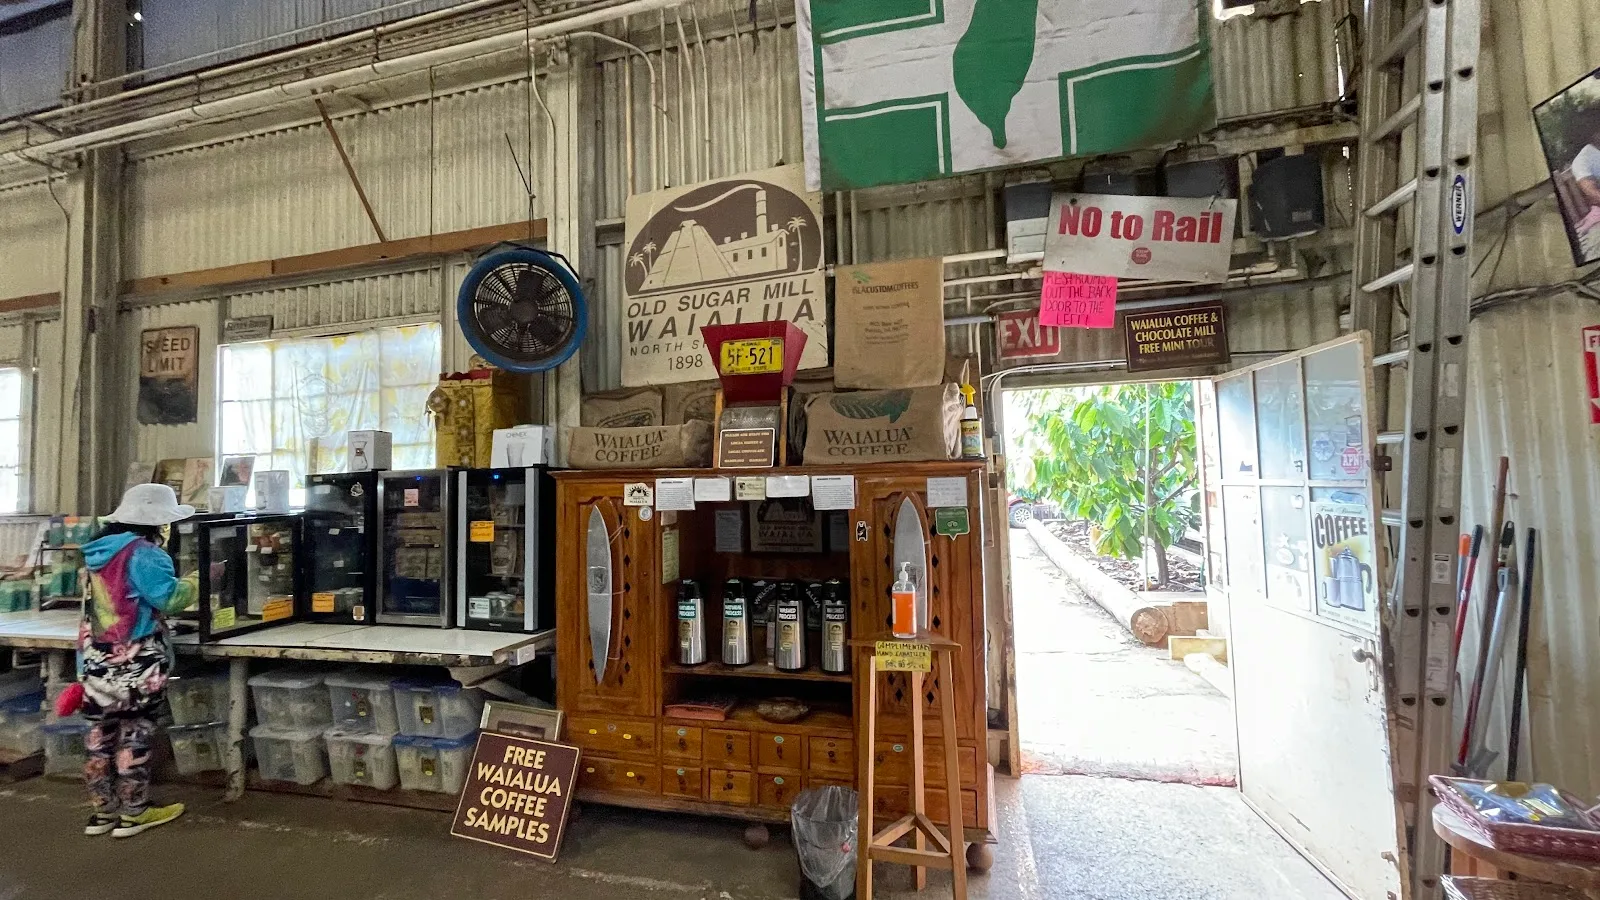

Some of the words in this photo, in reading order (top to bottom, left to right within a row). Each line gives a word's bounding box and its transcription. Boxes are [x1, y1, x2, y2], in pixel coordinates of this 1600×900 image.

[1059, 205, 1103, 238] NO
[1110, 210, 1144, 241] to
[1152, 210, 1223, 243] Rail
[628, 299, 667, 319] OLD
[677, 287, 751, 312] SUGAR
[763, 279, 814, 300] MILL
[1045, 286, 1065, 299] OUT
[1065, 286, 1083, 298] THE
[1086, 285, 1112, 299] BACK
[1073, 301, 1087, 313] TO
[1088, 301, 1105, 314] THE
[1130, 317, 1173, 331] WAIALUA
[1173, 314, 1209, 326] COFFEE
[1210, 312, 1218, 322] &
[1135, 327, 1192, 342] CHOCOLATE
[1194, 325, 1217, 337] MILL
[630, 342, 684, 356] NORTH
[1139, 342, 1161, 354] FREE
[1162, 340, 1185, 352] MINI
[1186, 338, 1214, 350] TOUR
[667, 354, 704, 371] 1898
[594, 430, 665, 449] WAIALUA
[823, 427, 912, 446] WAIALUA
[595, 445, 663, 463] COFFEE
[827, 443, 911, 457] COFFEE
[1314, 512, 1368, 549] COFFEE
[503, 745, 547, 770] FREE
[476, 762, 562, 797] WAIALUA
[480, 786, 548, 818] COFFEE
[463, 807, 550, 844] SAMPLES
